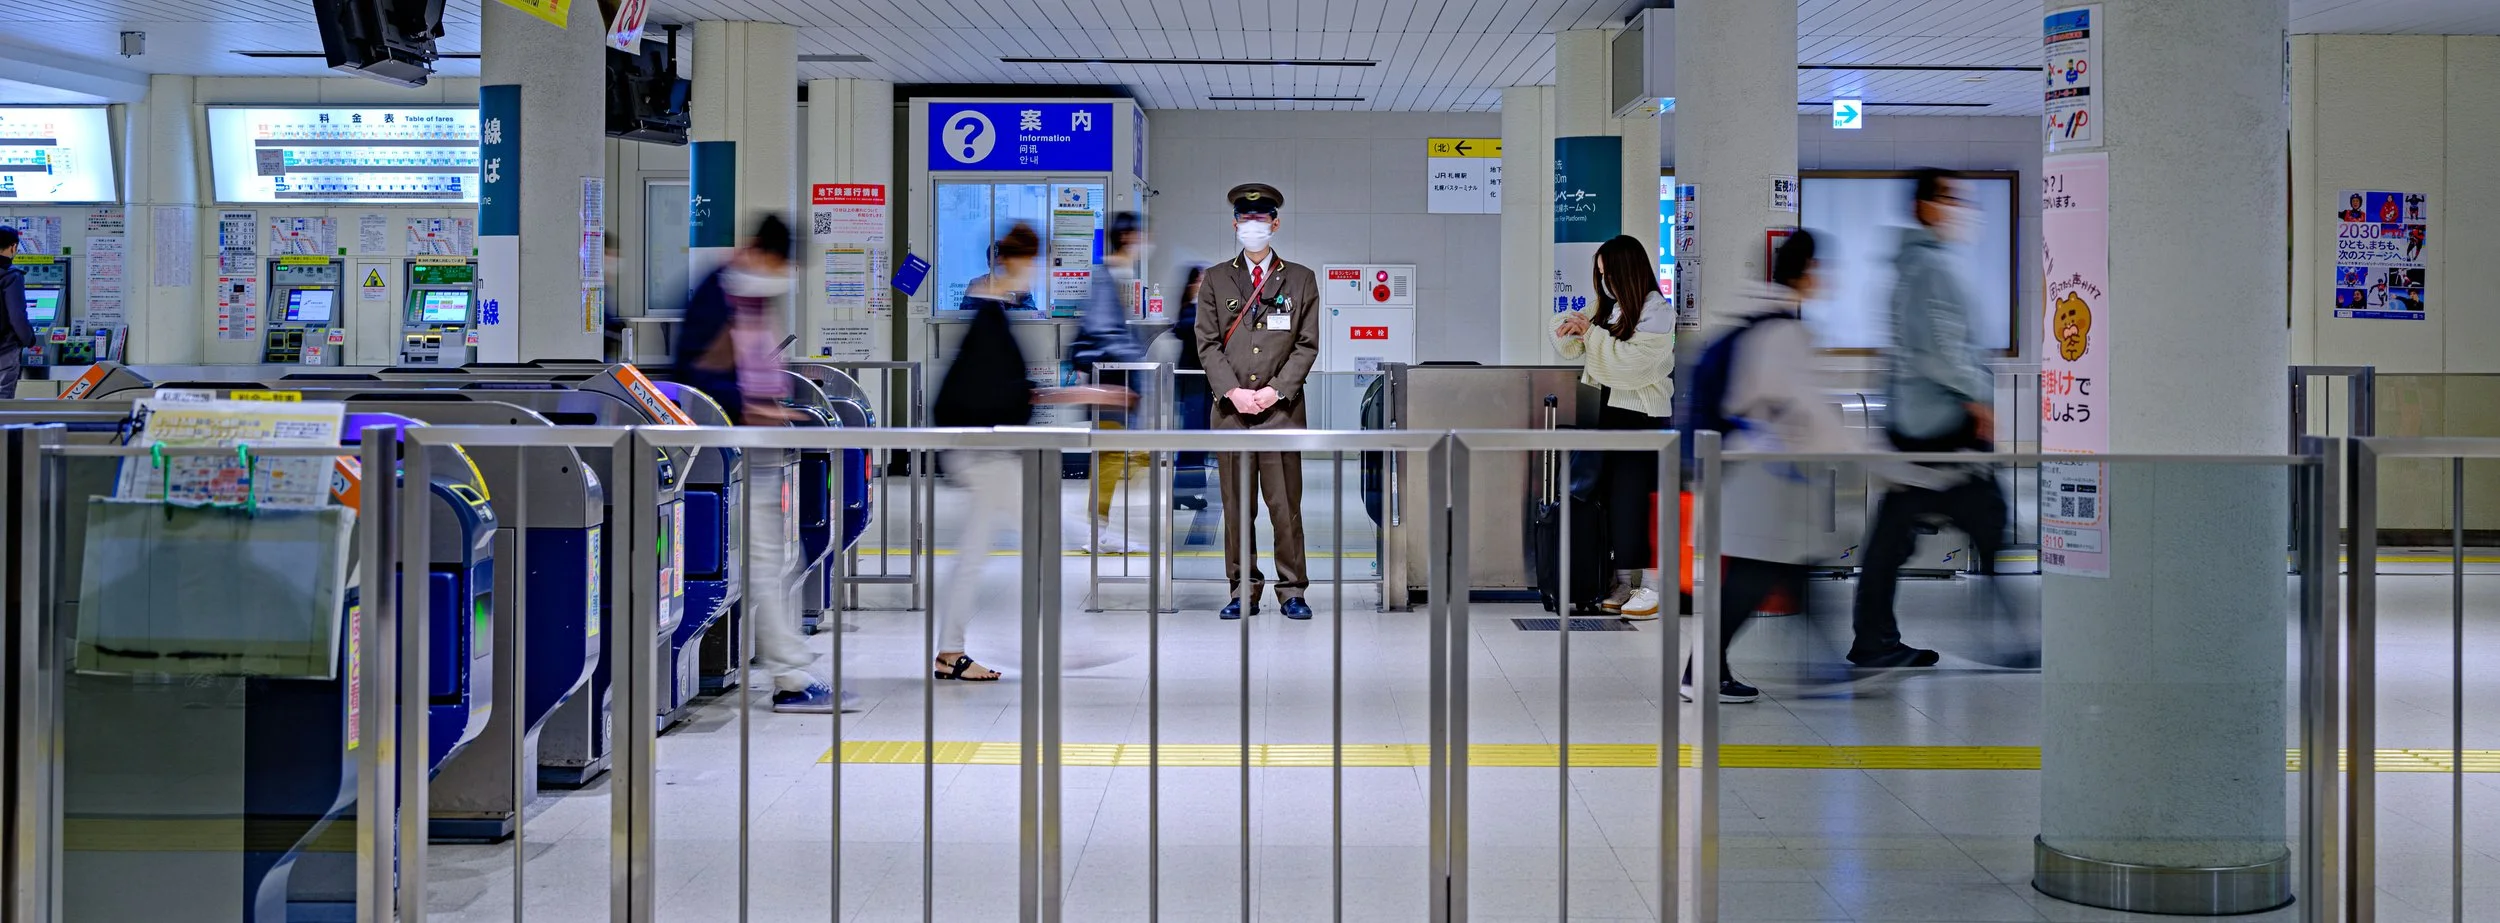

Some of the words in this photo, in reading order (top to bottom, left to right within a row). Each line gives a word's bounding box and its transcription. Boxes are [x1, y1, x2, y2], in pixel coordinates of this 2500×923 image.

[319, 113, 395, 124] 料金表
[1019, 110, 1092, 132] 案内
[484, 118, 502, 145] 線
[1019, 134, 1071, 143] Information
[1019, 145, 1038, 154] 问讯
[1019, 155, 1039, 165] 안내
[484, 158, 501, 184] ば
[818, 187, 879, 197] 地下鉄運行情報
[1434, 184, 1478, 192] 札幌バスターミナル
[2339, 223, 2380, 239] 2030
[2339, 240, 2400, 251] ひとも、まちも、
[2338, 250, 2406, 261] 次のステージへ。
[1554, 296, 1586, 313] 豊線
[477, 299, 500, 325] 線
[1354, 329, 1385, 337] 消火栓
